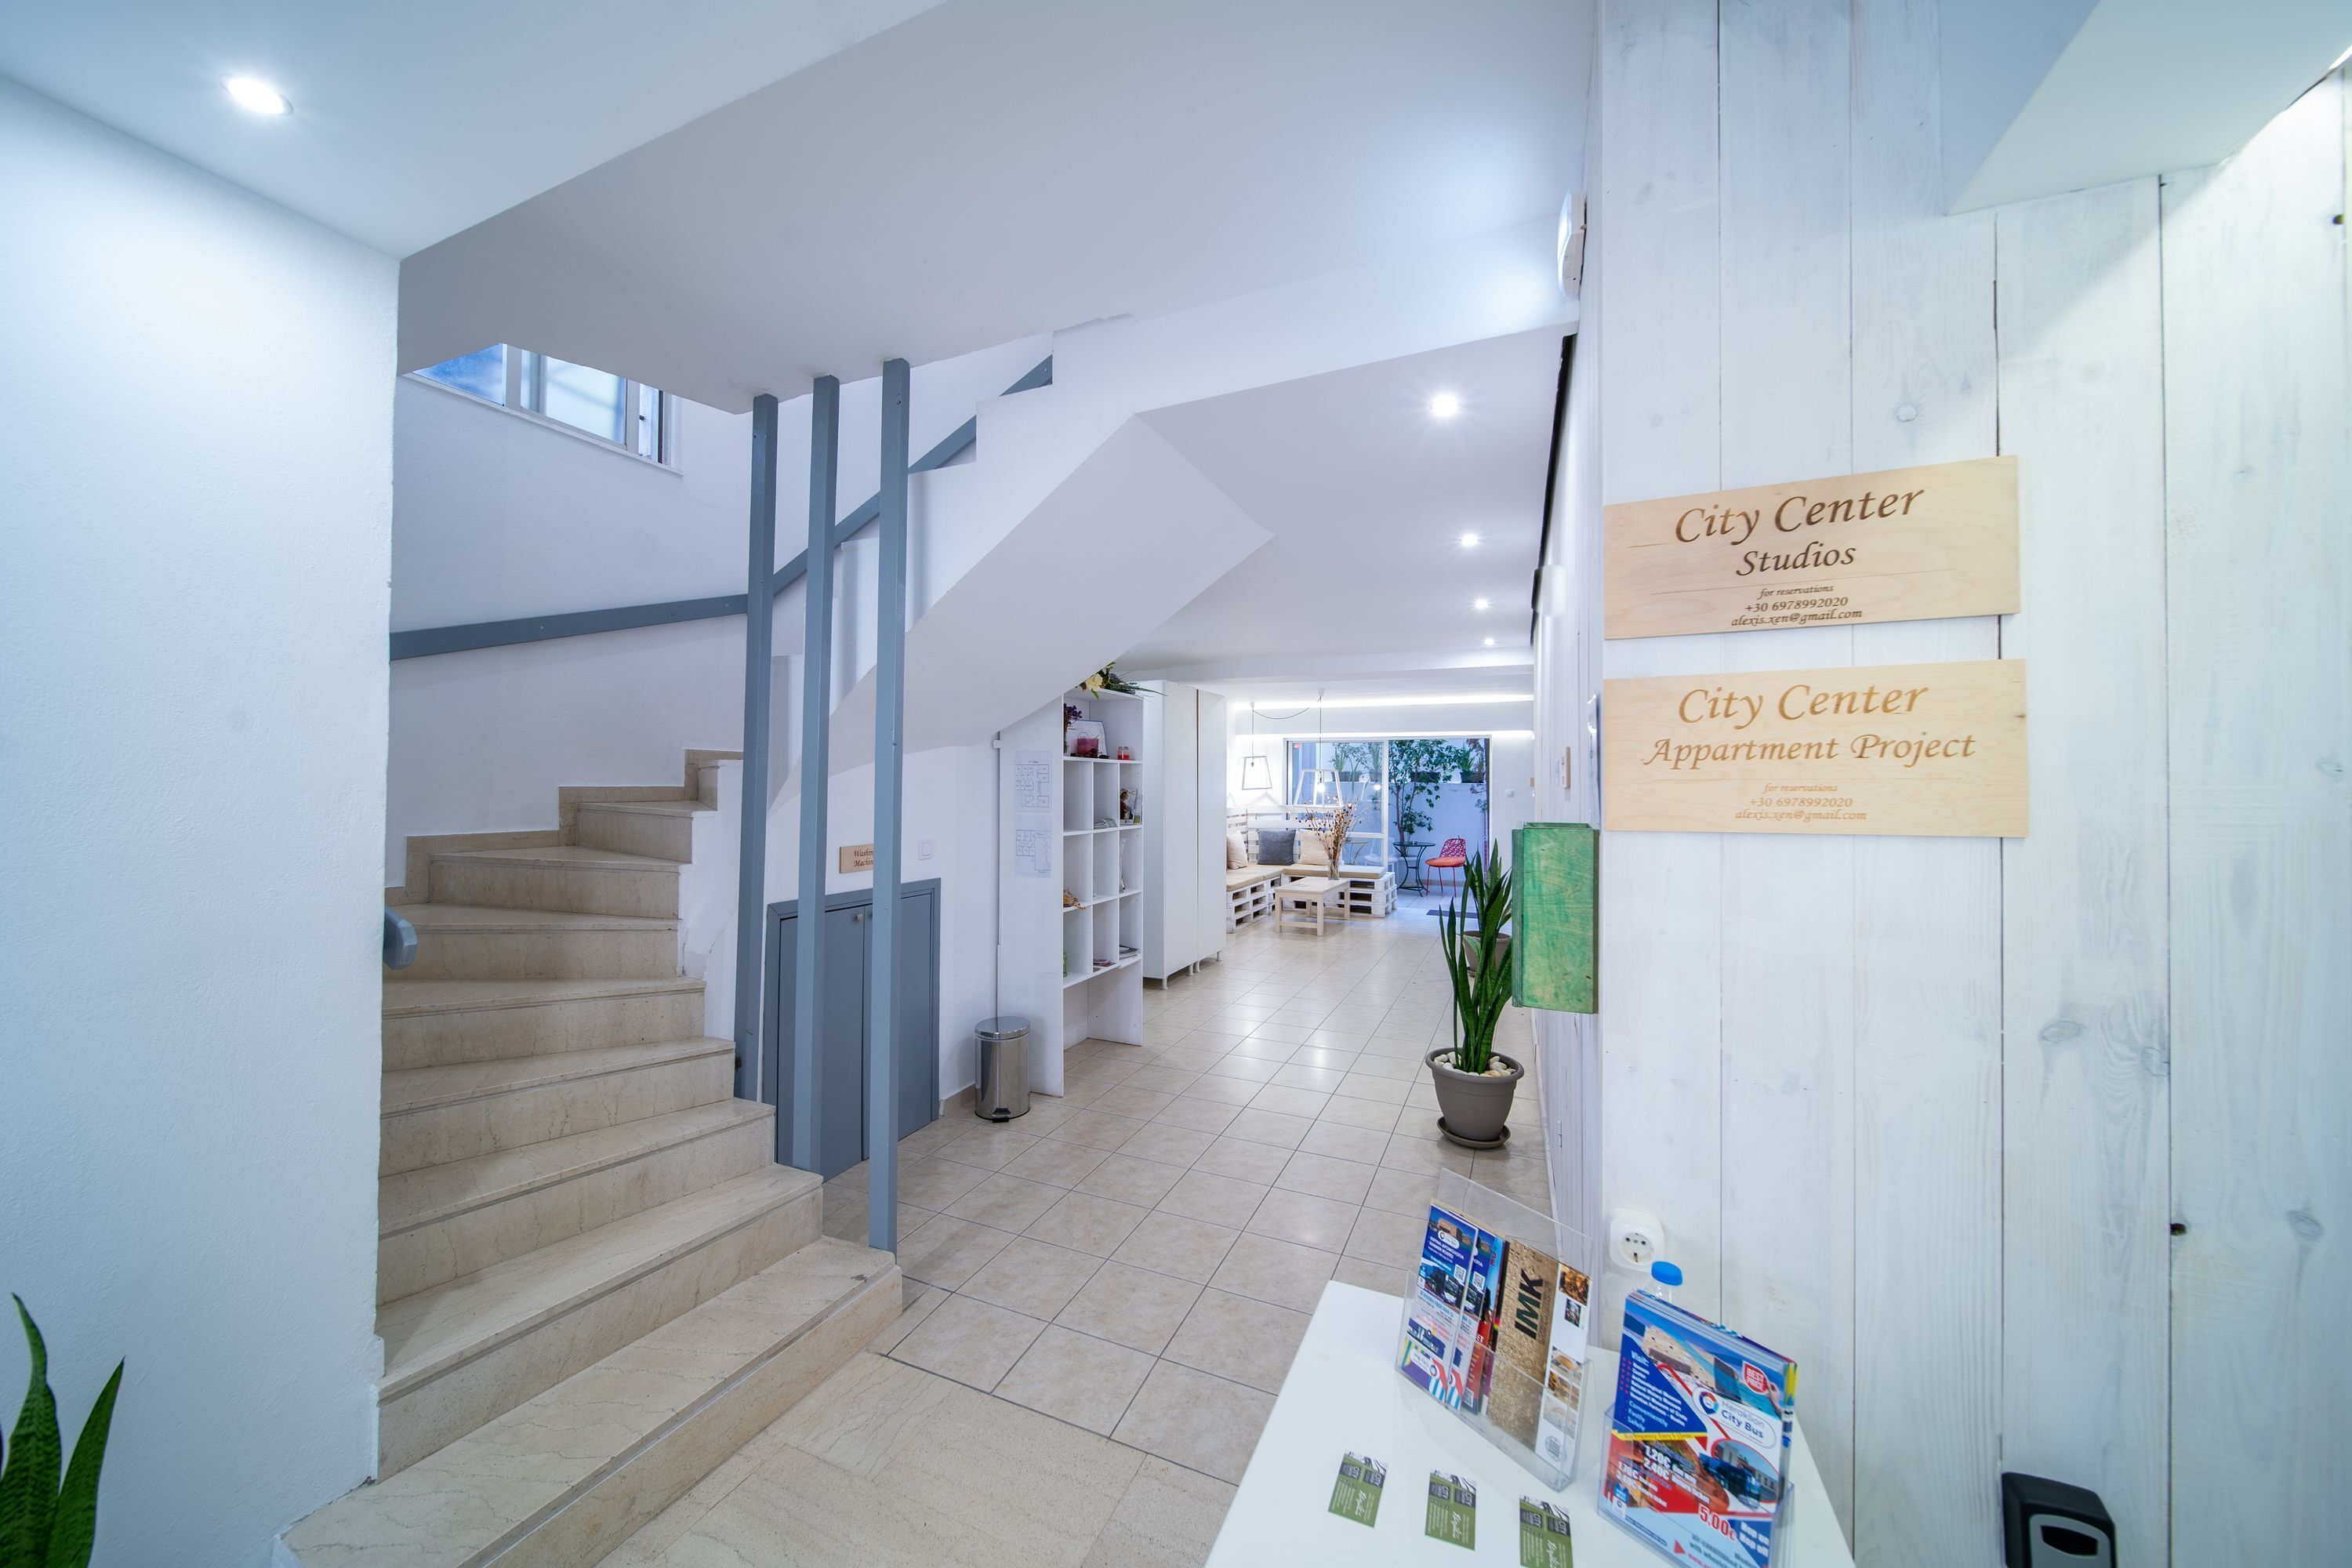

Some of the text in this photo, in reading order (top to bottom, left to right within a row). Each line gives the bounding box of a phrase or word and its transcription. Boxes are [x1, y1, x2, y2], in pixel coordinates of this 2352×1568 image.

[1675, 488, 1926, 546] City Center
[1735, 541, 1857, 576] Studios
[1758, 583, 1834, 600] for reservations
[1744, 596, 1849, 613] +30 6978992020
[1731, 608, 1863, 626] alexis.xen@gmail.com
[1679, 684, 1929, 729] City Center
[1643, 731, 1976, 770] Appartment Project
[1763, 782, 1838, 794] for reservations
[1748, 796, 1853, 808] +30 6978992020
[1735, 808, 1867, 822] alexis.xen@gmail.com
[853, 848, 874, 858] Washin
[853, 858, 874, 868] Machin
[1515, 1268, 1544, 1340] IMK
[1721, 1410, 1742, 1428] City
[1744, 1421, 1764, 1439] Bus
